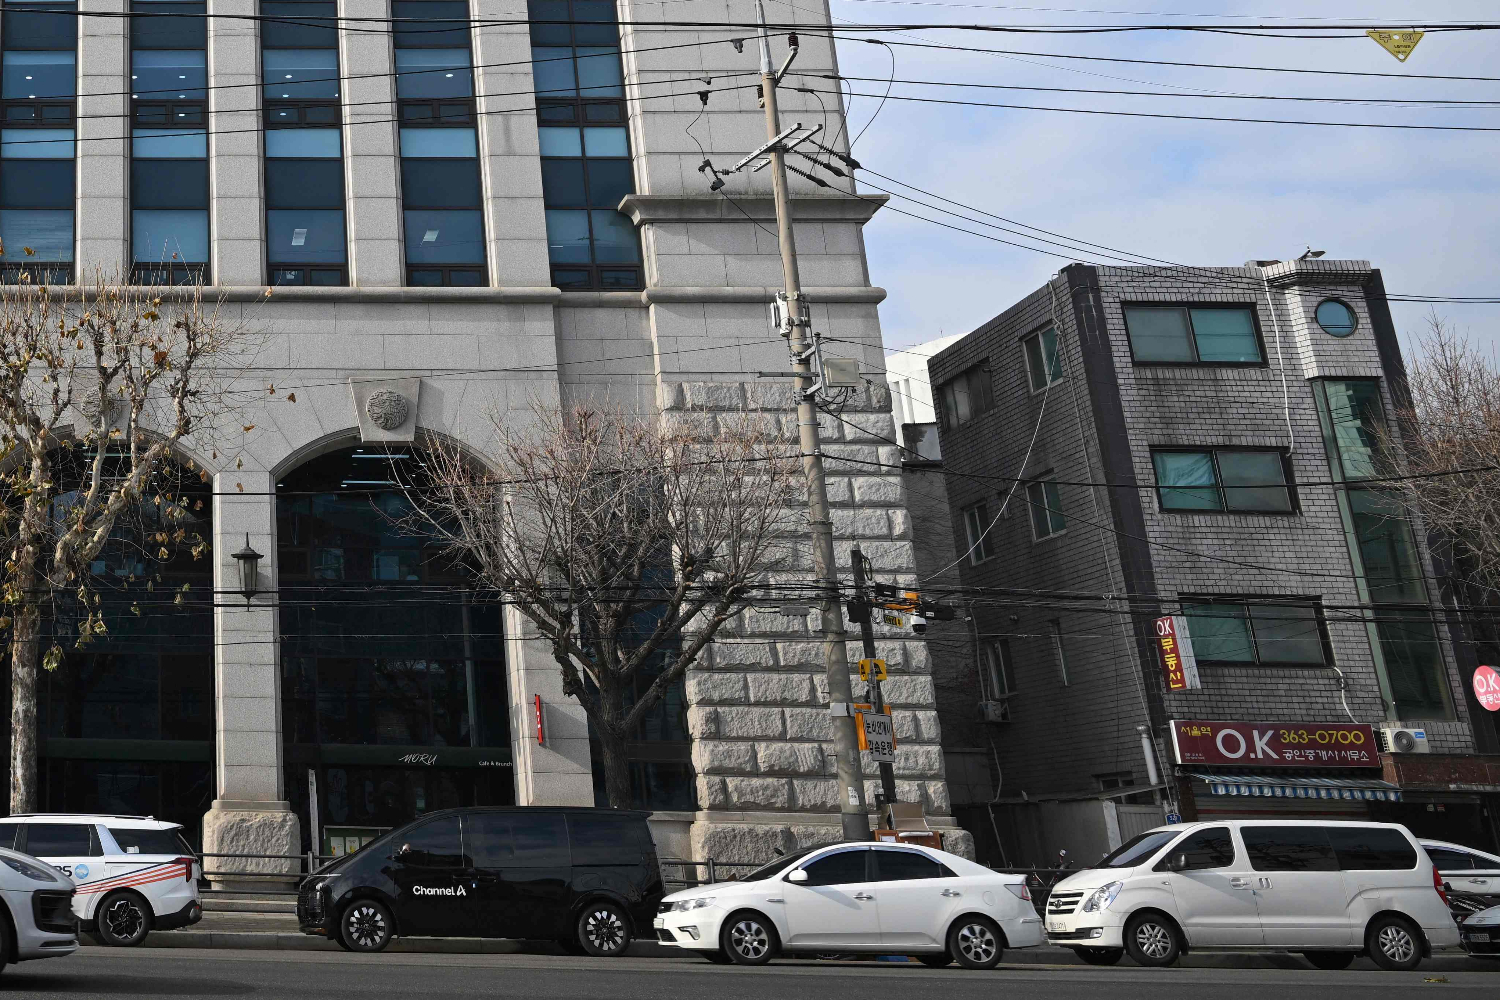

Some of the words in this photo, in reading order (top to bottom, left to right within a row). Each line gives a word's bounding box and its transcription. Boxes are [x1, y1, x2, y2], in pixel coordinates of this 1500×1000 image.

[1161, 636, 1182, 688] 부동산
[1181, 725, 1212, 737] 서울역
[1280, 729, 1365, 744] 363-0700
[1216, 729, 1279, 759] O.K
[1282, 750, 1339, 761] 공인중개사
[1341, 750, 1370, 761] 사무소
[412, 885, 455, 896] Channel
[456, 884, 467, 896] A
